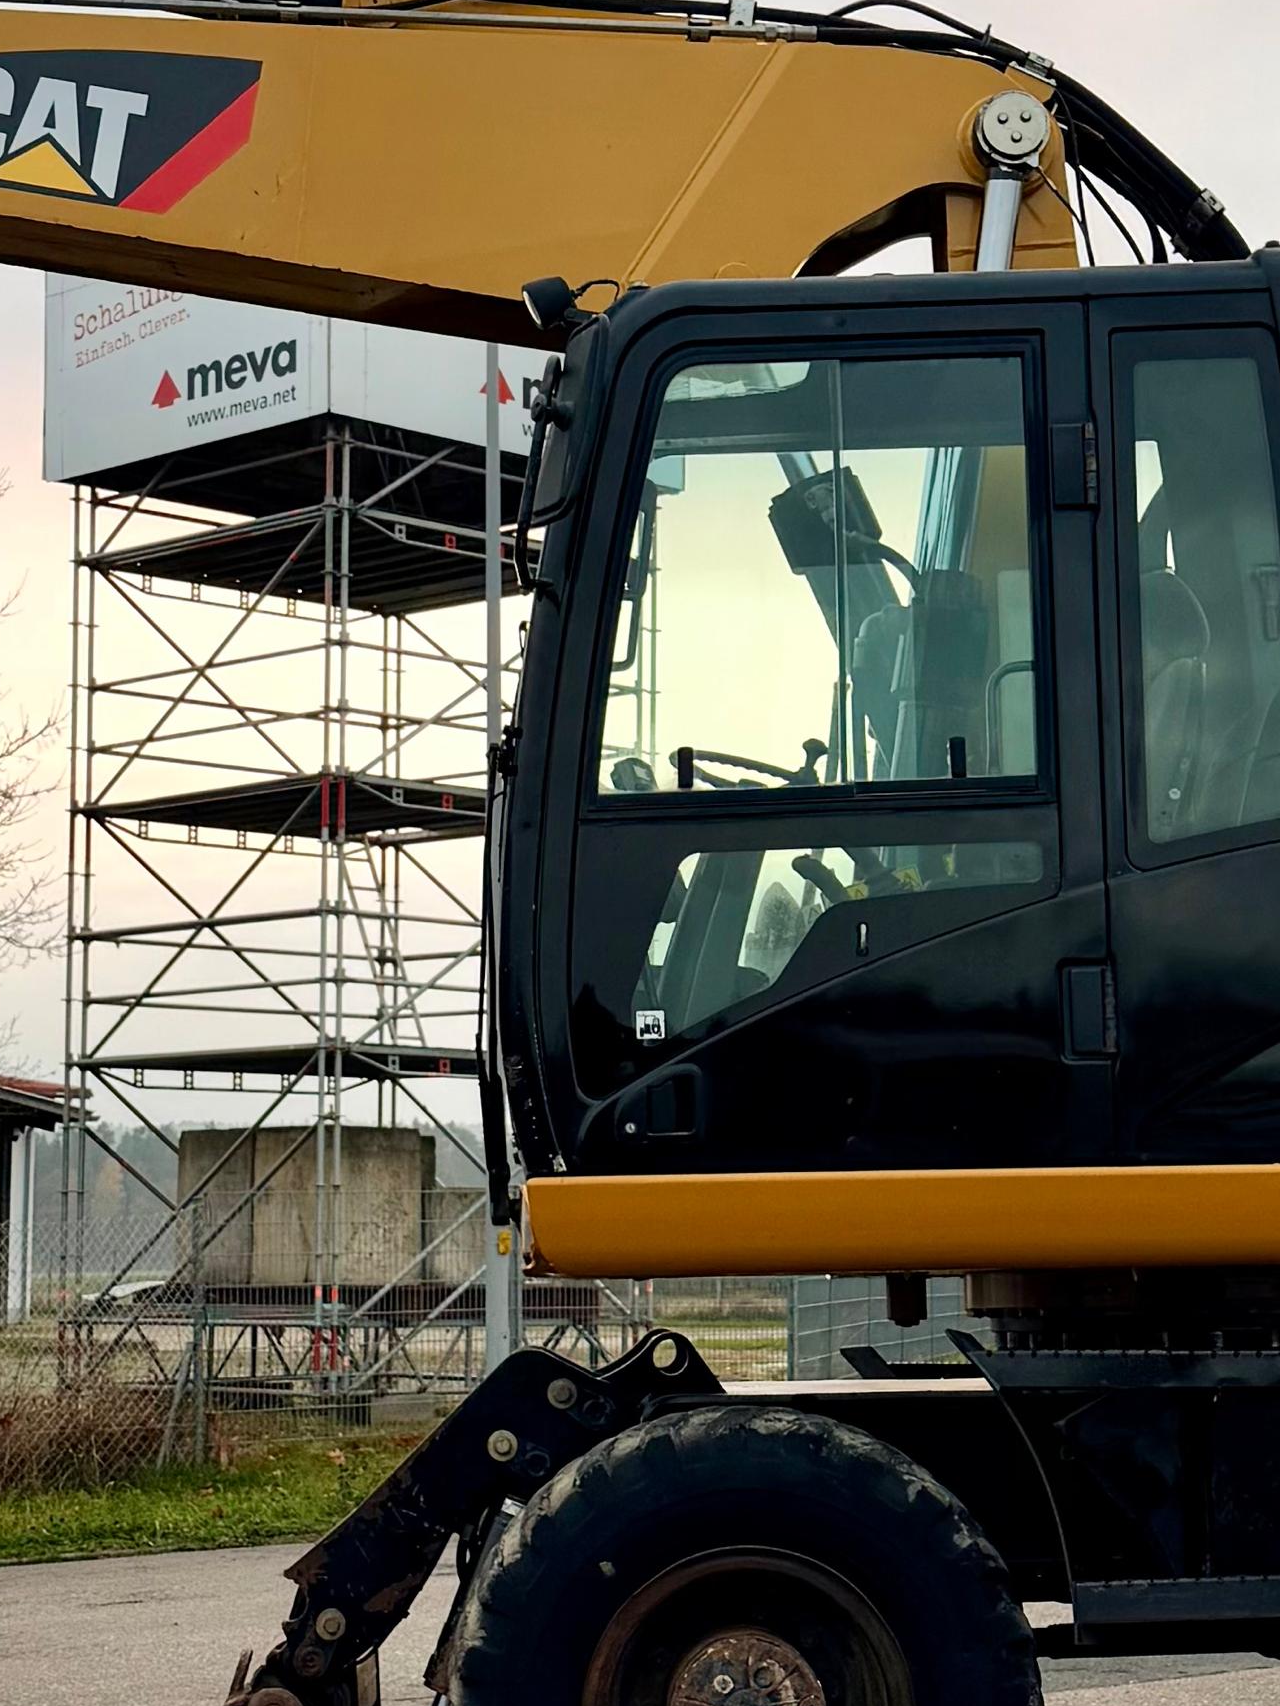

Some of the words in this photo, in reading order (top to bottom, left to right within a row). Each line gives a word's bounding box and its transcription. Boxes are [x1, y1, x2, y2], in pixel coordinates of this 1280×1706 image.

[75, 332, 135, 368] Einfach.
[139, 308, 191, 340] Clever.
[187, 339, 297, 400] meva
[187, 385, 297, 427] www.meva.net
